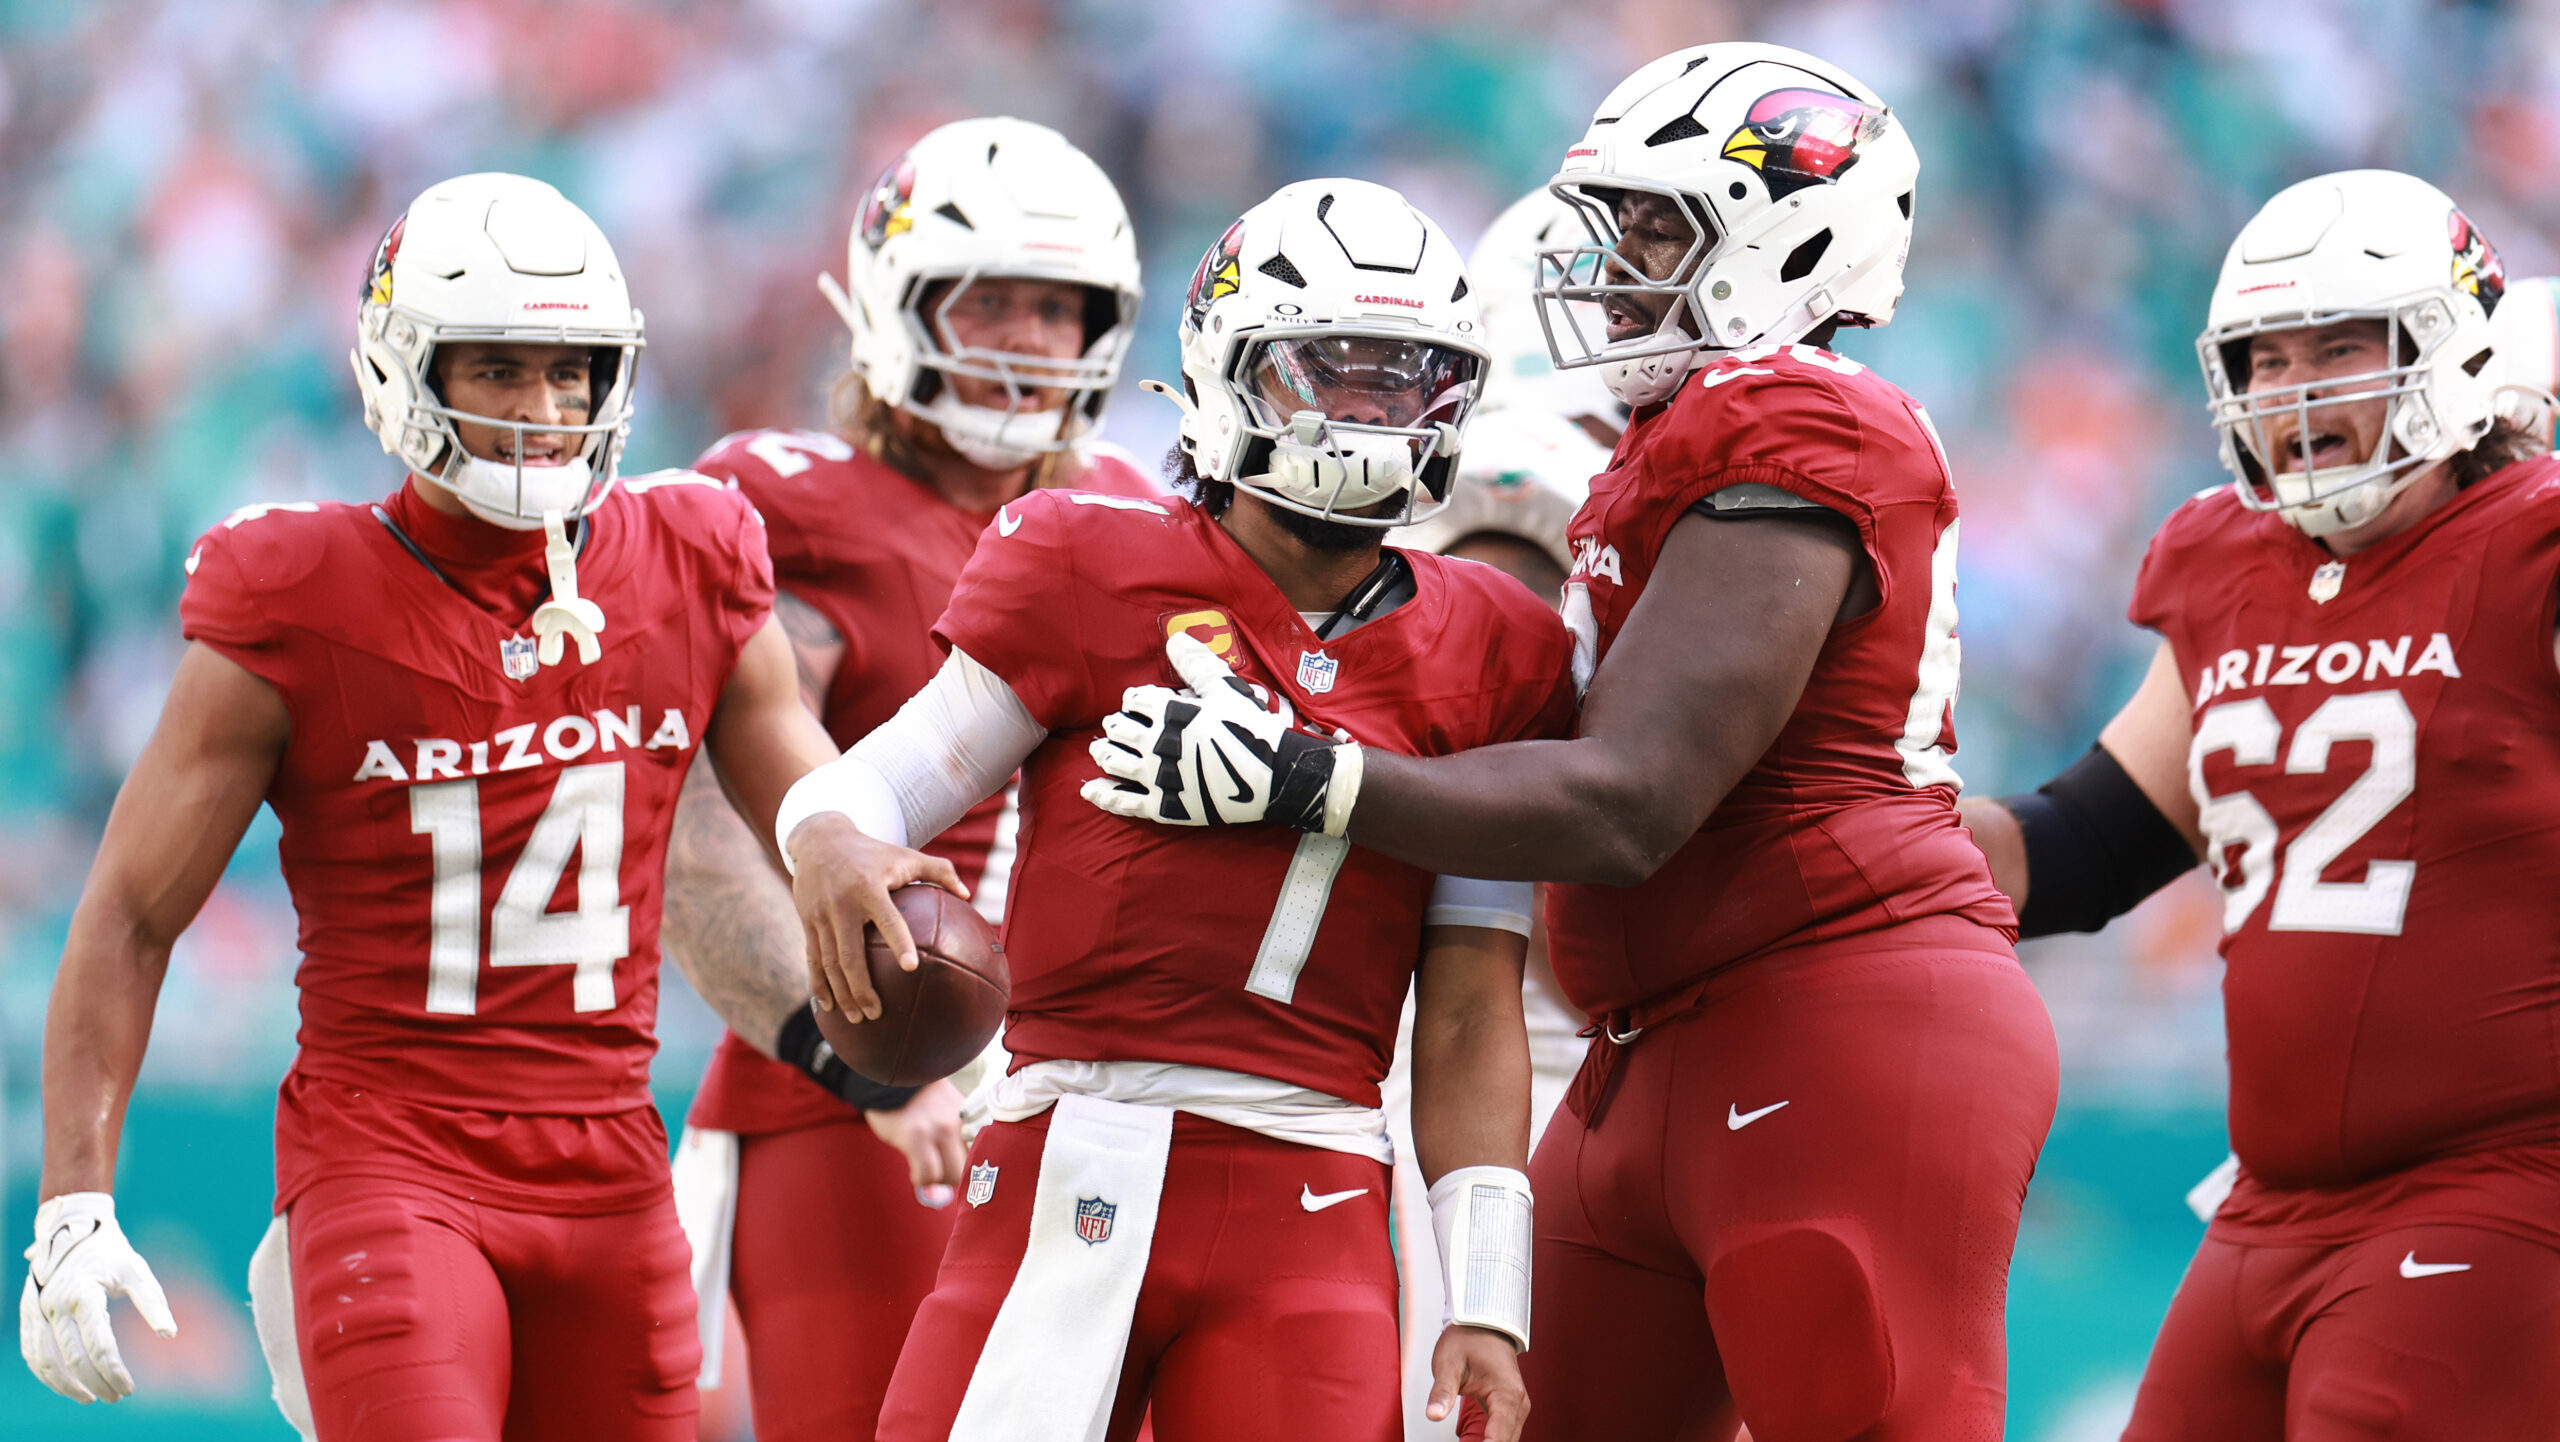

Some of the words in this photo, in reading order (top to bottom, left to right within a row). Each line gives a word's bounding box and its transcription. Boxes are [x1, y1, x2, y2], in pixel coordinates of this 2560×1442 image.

[1266, 314, 1308, 324] OAKLEY
[1354, 294, 1425, 309] CARDINALS
[1166, 609, 1233, 655] C
[1303, 667, 1327, 687] NFL
[353, 704, 691, 782] ARIZONA
[2187, 688, 2418, 936] 62
[408, 760, 631, 1015] 14
[1243, 831, 1352, 1005] 1
[970, 1182, 988, 1200] NFL
[1079, 1215, 1108, 1240] NFL
